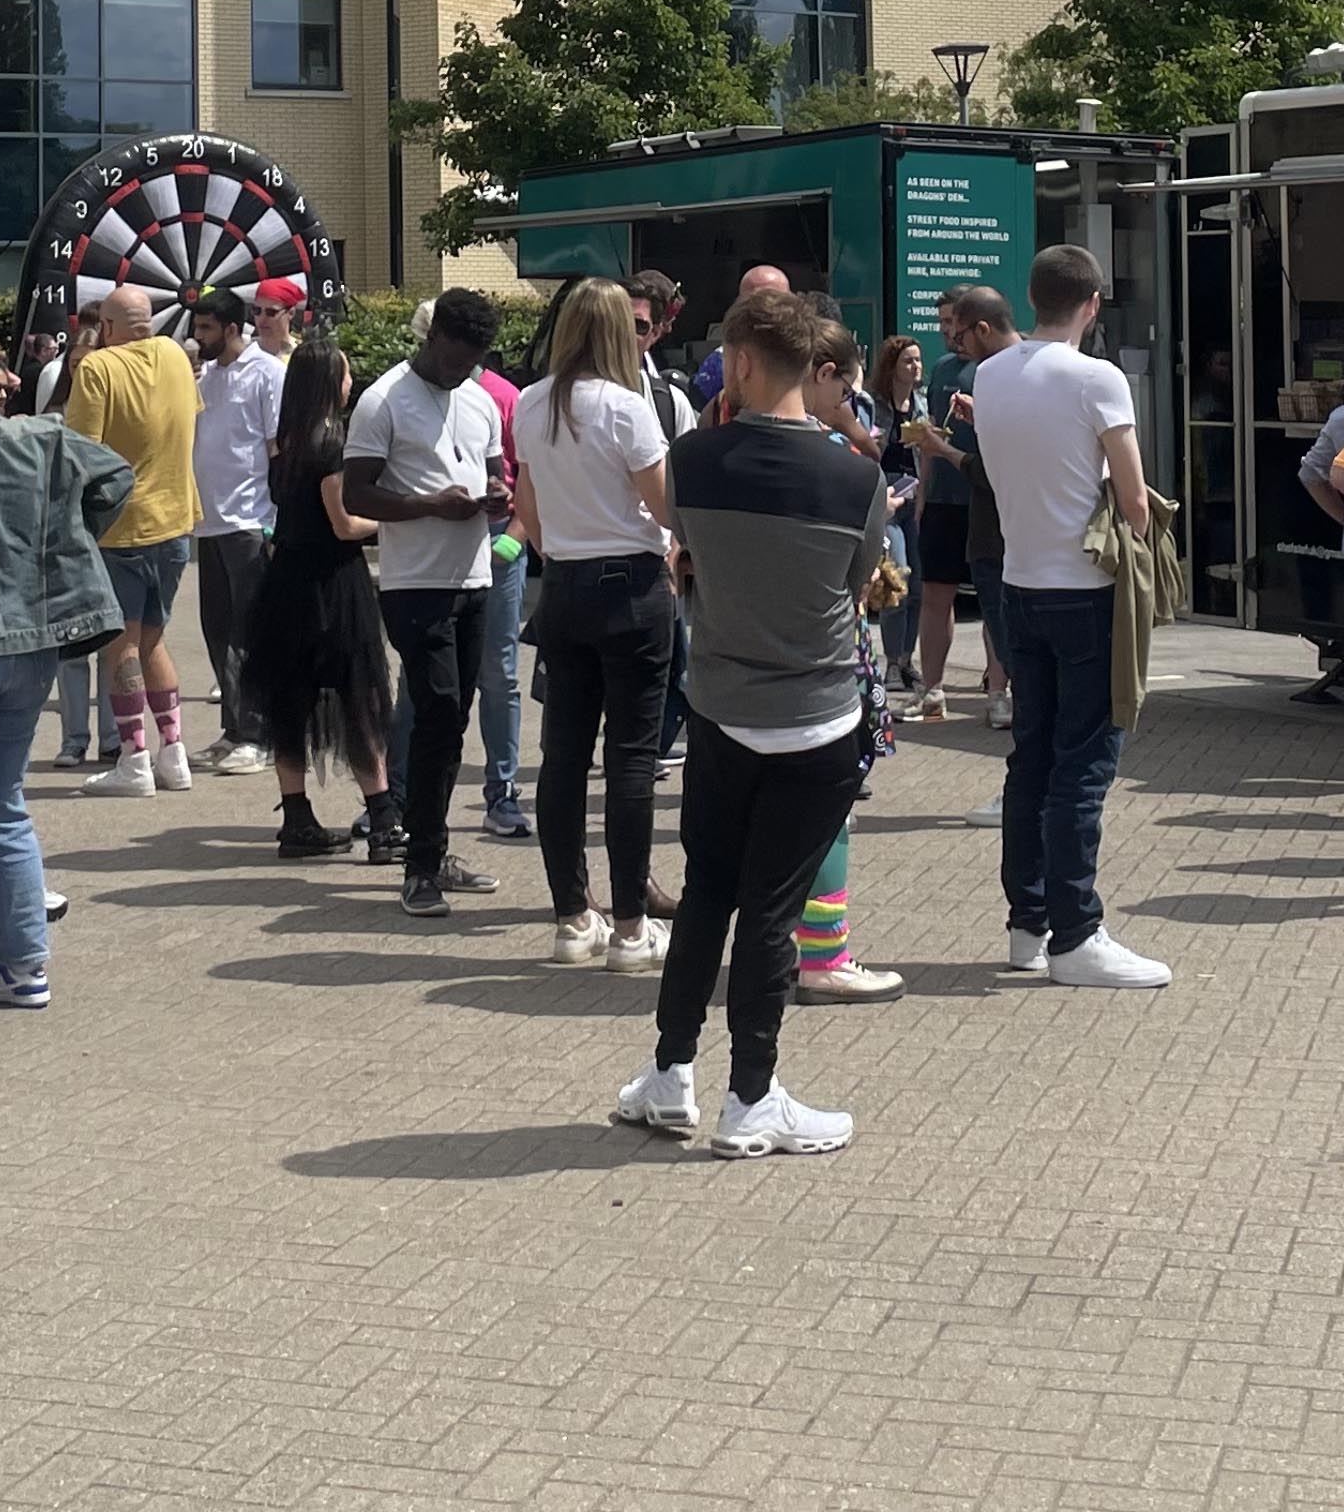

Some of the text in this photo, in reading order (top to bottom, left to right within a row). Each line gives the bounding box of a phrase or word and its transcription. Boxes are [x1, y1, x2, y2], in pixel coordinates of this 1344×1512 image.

[146, 148, 158, 166] 5
[182, 140, 204, 158] 20
[227, 143, 236, 164] 1
[99, 167, 123, 186] 12
[263, 165, 283, 186] 18
[907, 177, 969, 189] AS SEEN ON THE
[75, 200, 88, 218] 9
[294, 196, 306, 214] 4
[907, 215, 998, 227] STREET FOOD INSPIRED
[907, 228, 1010, 242] FROM AROUND THE WORLD
[50, 240, 73, 259] 14
[309, 238, 330, 257] 13
[907, 252, 1000, 265] AVAILABLE FOR PRIVATE
[44, 285, 65, 304] 11
[323, 279, 334, 298] 6
[912, 306, 939, 316] WEDDI
[912, 323, 941, 332] PARTIE
